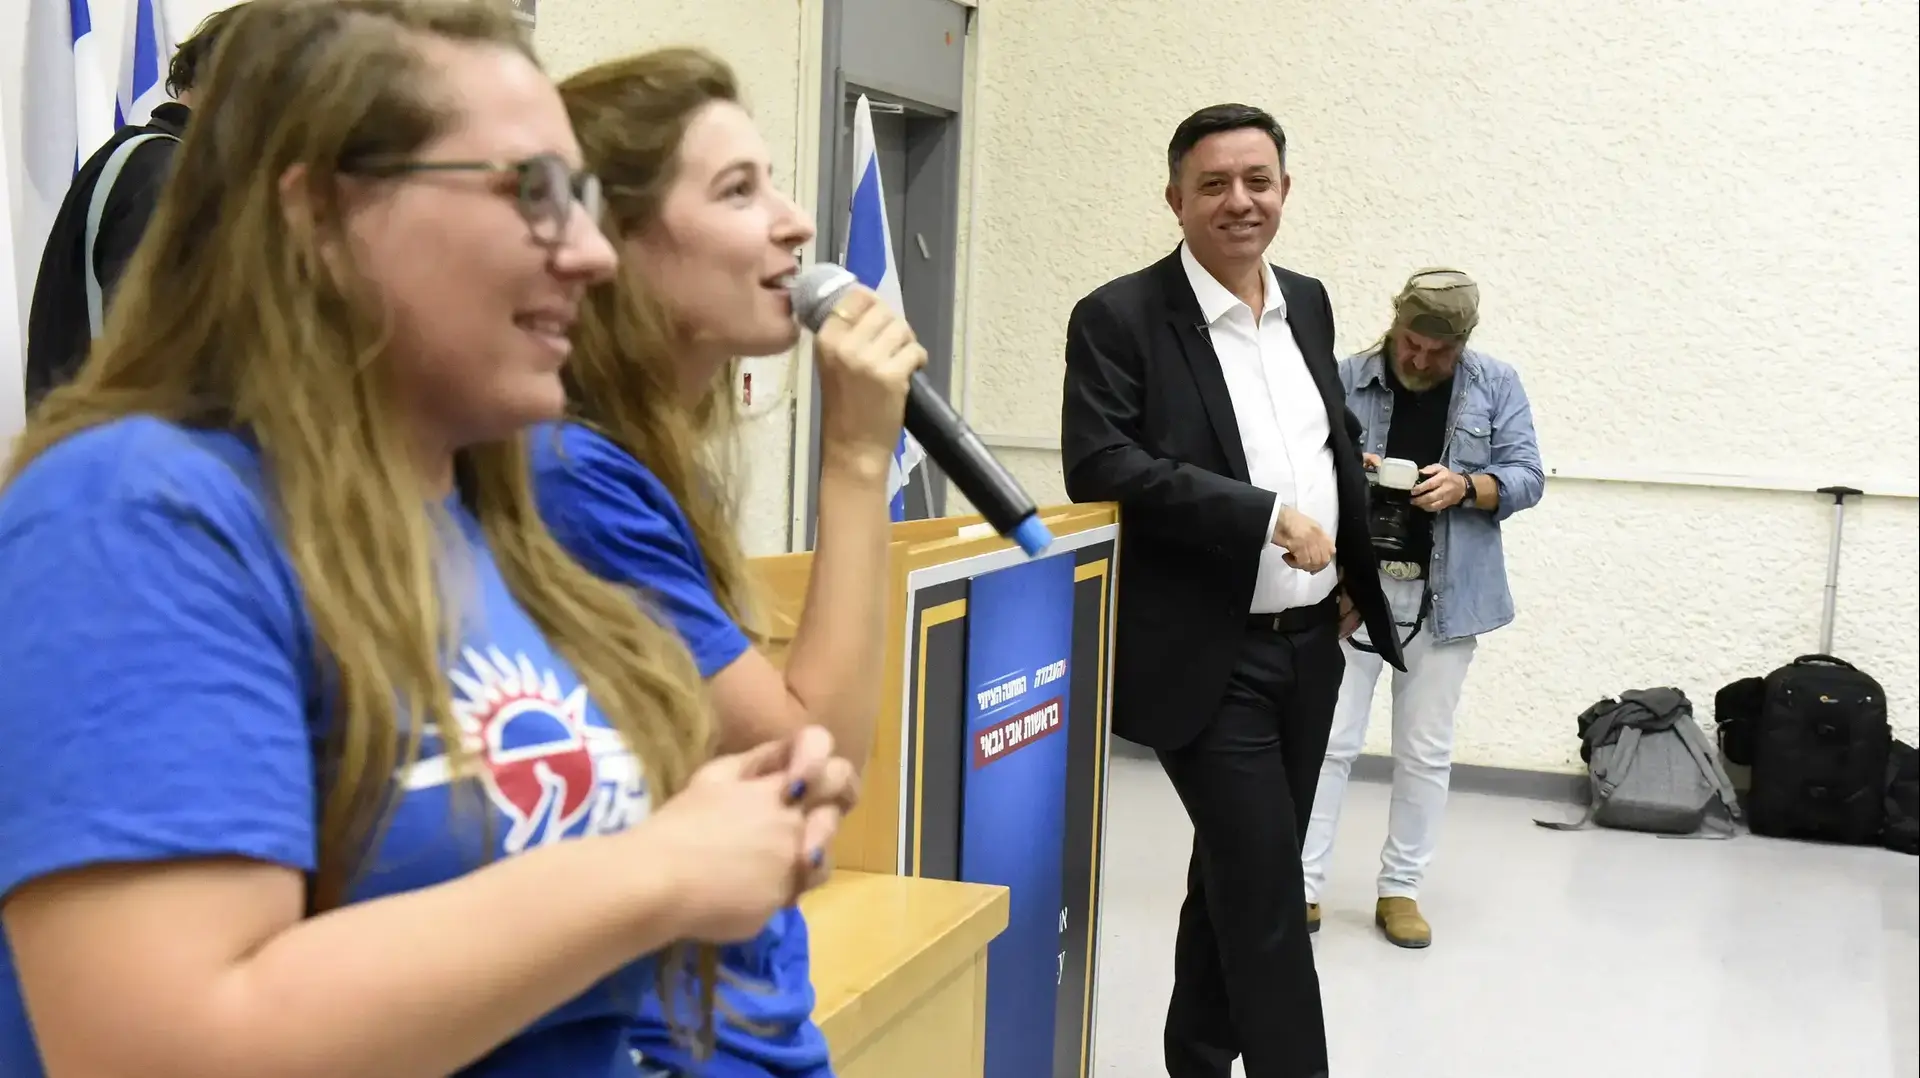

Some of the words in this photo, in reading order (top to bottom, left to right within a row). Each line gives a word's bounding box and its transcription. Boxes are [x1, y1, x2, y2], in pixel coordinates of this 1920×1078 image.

[1034, 660, 1064, 688] העבודה
[977, 686, 1002, 710] הציוני
[1003, 676, 1027, 701] המחנה
[1005, 719, 1023, 747] אבי
[1024, 703, 1059, 739] בראשות
[981, 728, 1004, 758] גבאי
